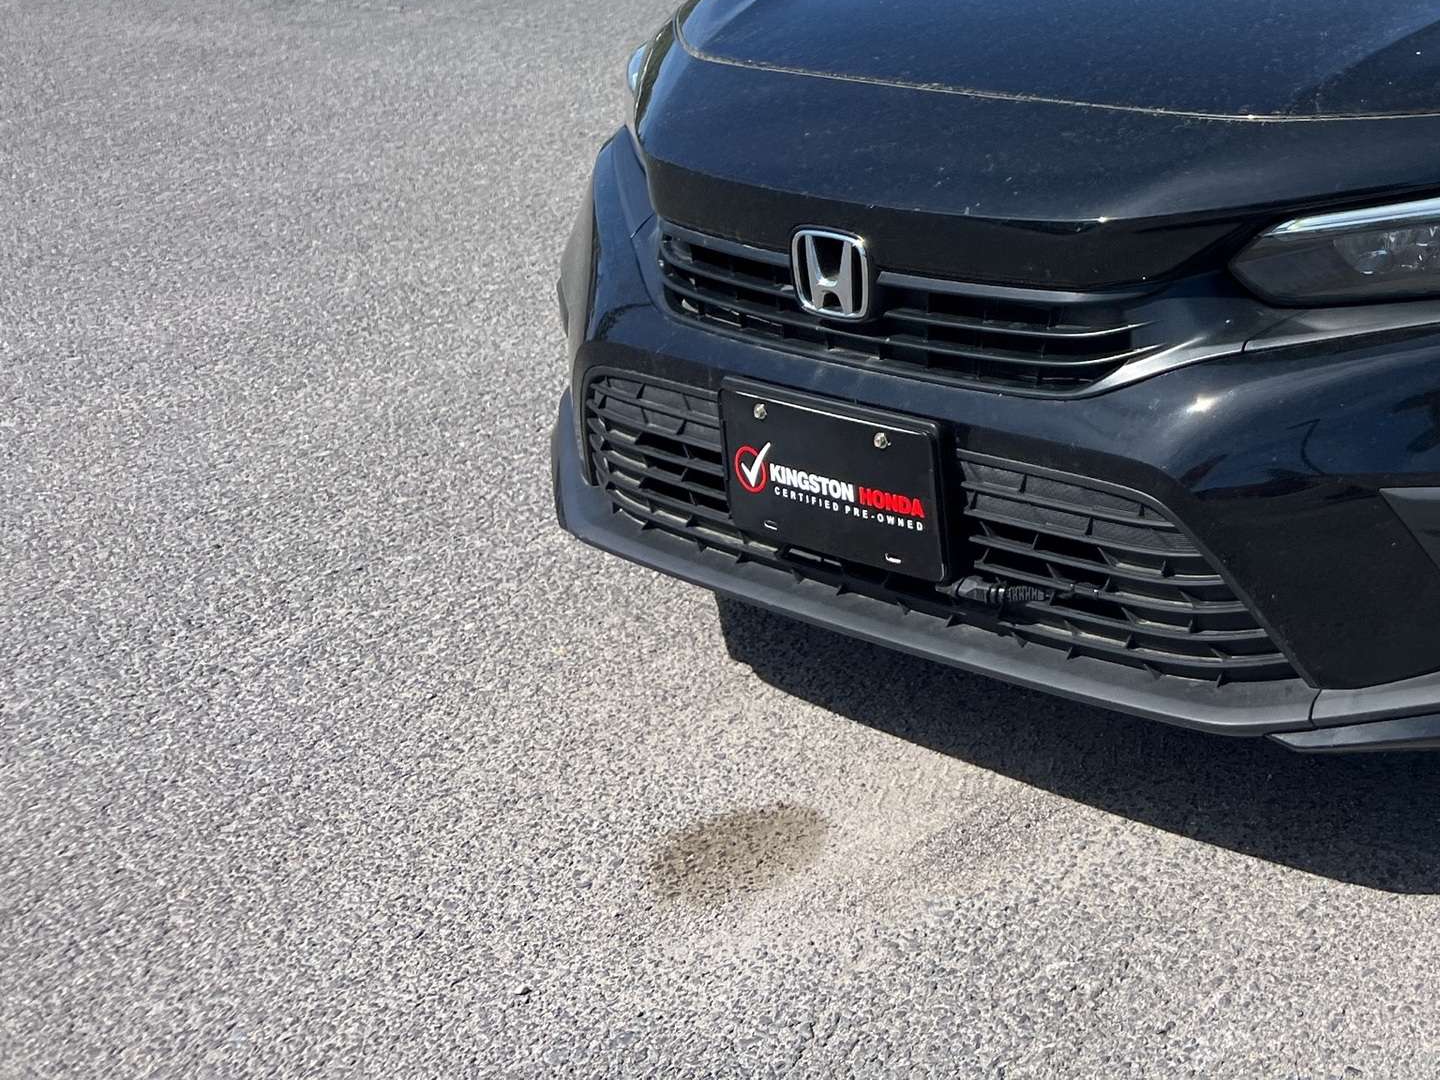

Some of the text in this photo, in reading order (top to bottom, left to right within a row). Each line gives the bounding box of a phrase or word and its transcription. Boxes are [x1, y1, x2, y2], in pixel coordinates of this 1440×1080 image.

[769, 463, 926, 519] KINGSTON HONDA
[774, 486, 924, 532] CERTIFIED PRE-OWNED
